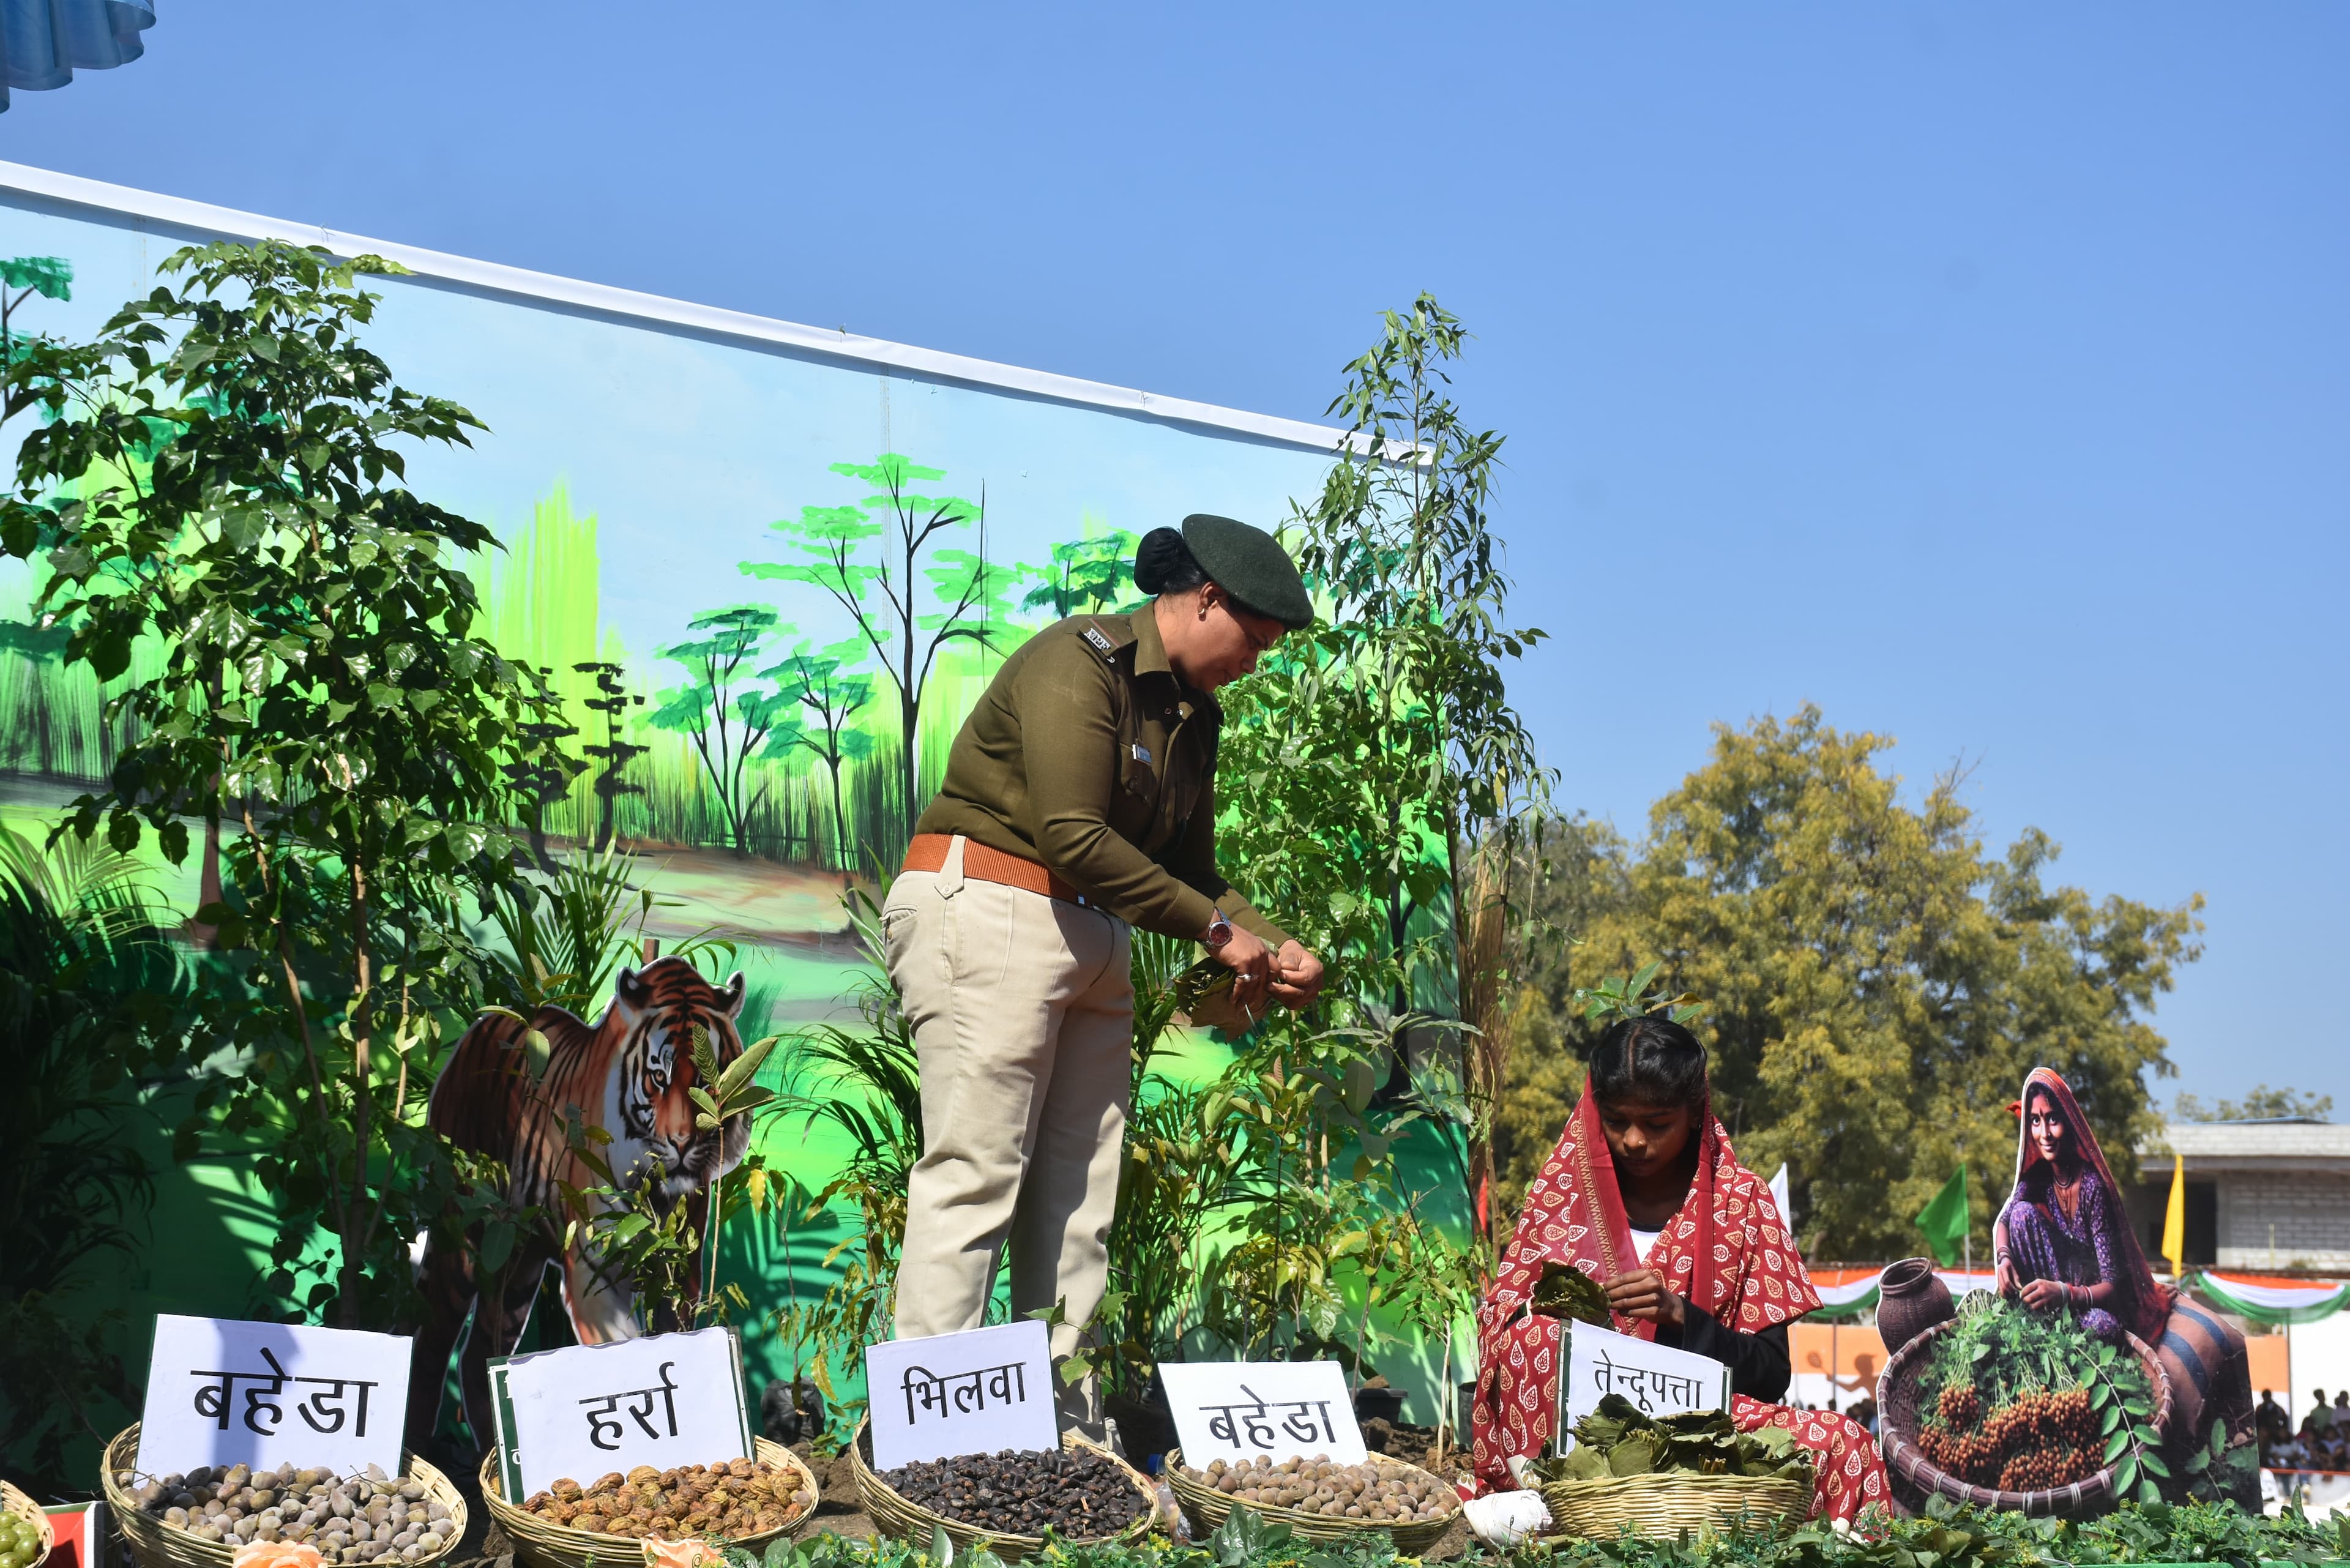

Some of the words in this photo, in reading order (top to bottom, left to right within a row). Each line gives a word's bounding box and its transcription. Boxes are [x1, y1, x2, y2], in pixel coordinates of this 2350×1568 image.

[190, 1347, 379, 1437] बहेडा
[579, 1361, 679, 1450] हर्रा
[900, 1361, 1027, 1425] भिलवा
[1592, 1348, 1704, 1413] तेन्दूपत्ता
[1199, 1384, 1337, 1449] बहेडा
